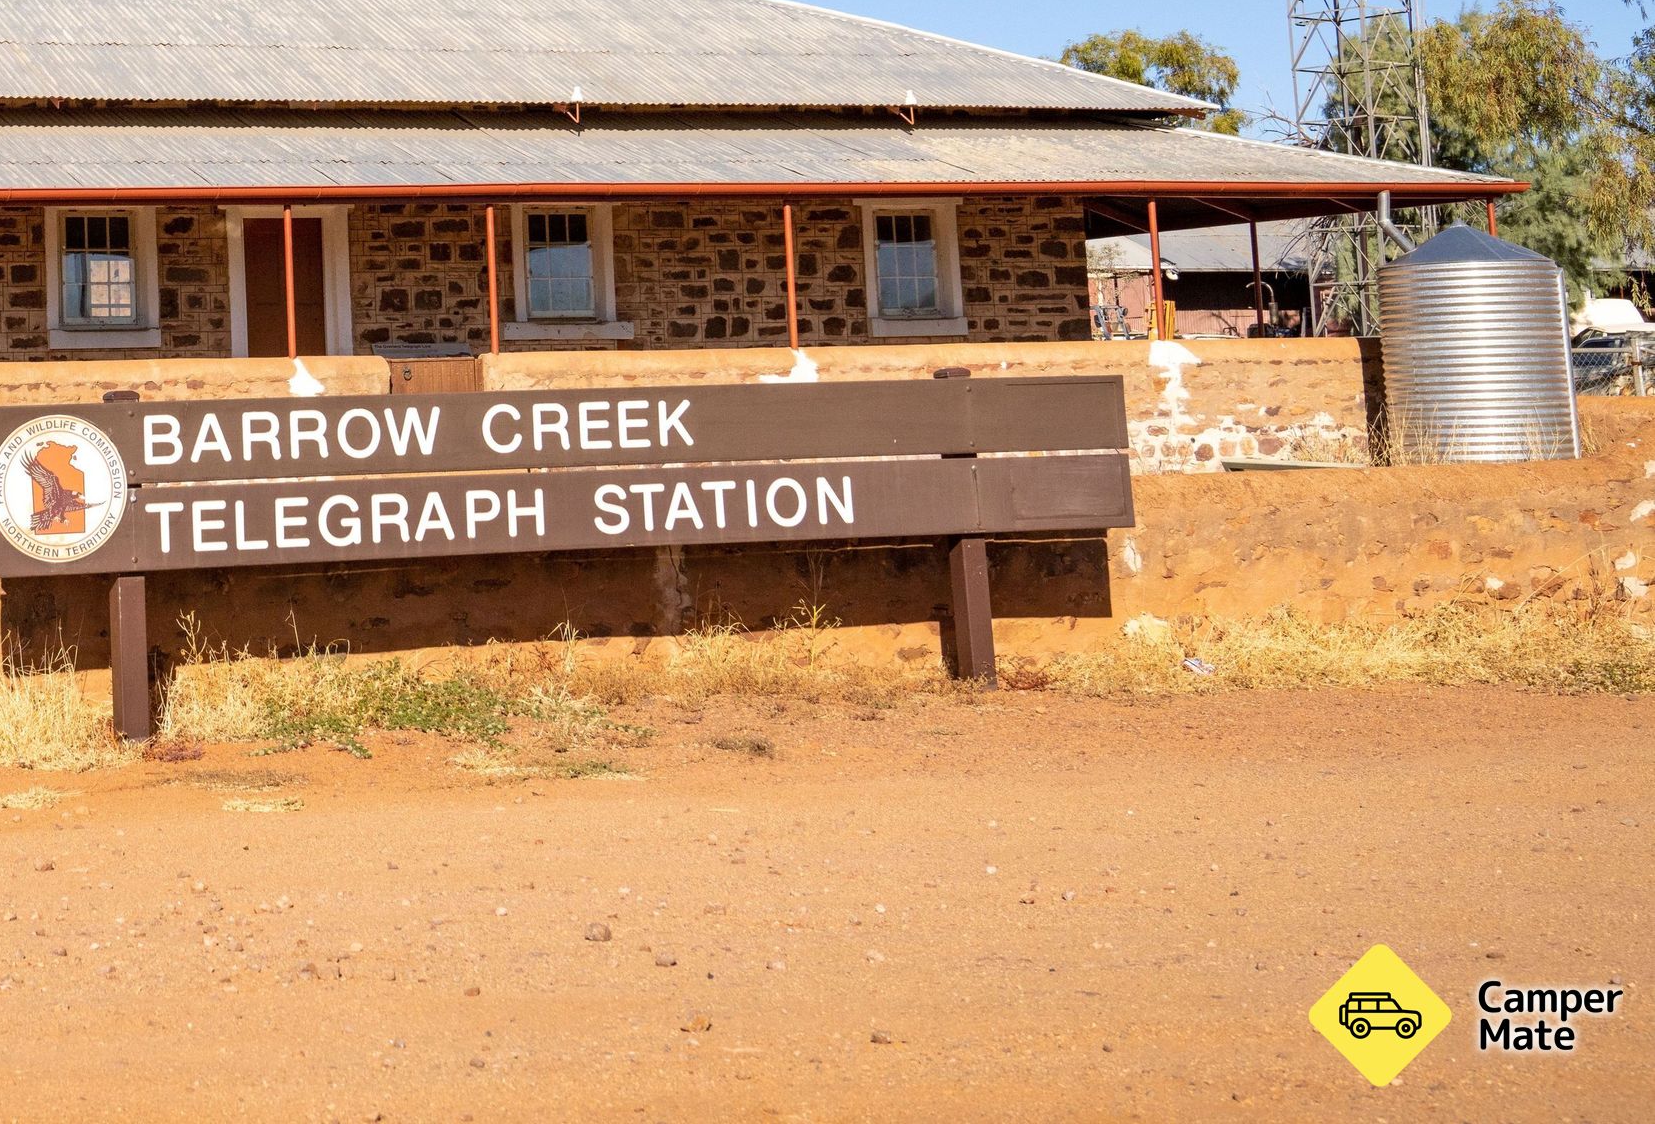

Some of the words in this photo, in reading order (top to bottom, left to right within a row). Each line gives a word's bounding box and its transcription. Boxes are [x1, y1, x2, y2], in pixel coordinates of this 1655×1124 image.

[4, 436, 23, 460] AND
[26, 420, 77, 435] WILDLIFE
[81, 427, 122, 500] COMMISSION
[143, 406, 441, 466] BARROW
[481, 399, 694, 454] CREEK
[2, 518, 59, 558] NORTHERN
[66, 512, 116, 557] TERRITORY
[144, 488, 545, 554] TELEGRAPH
[594, 475, 854, 535] STATION
